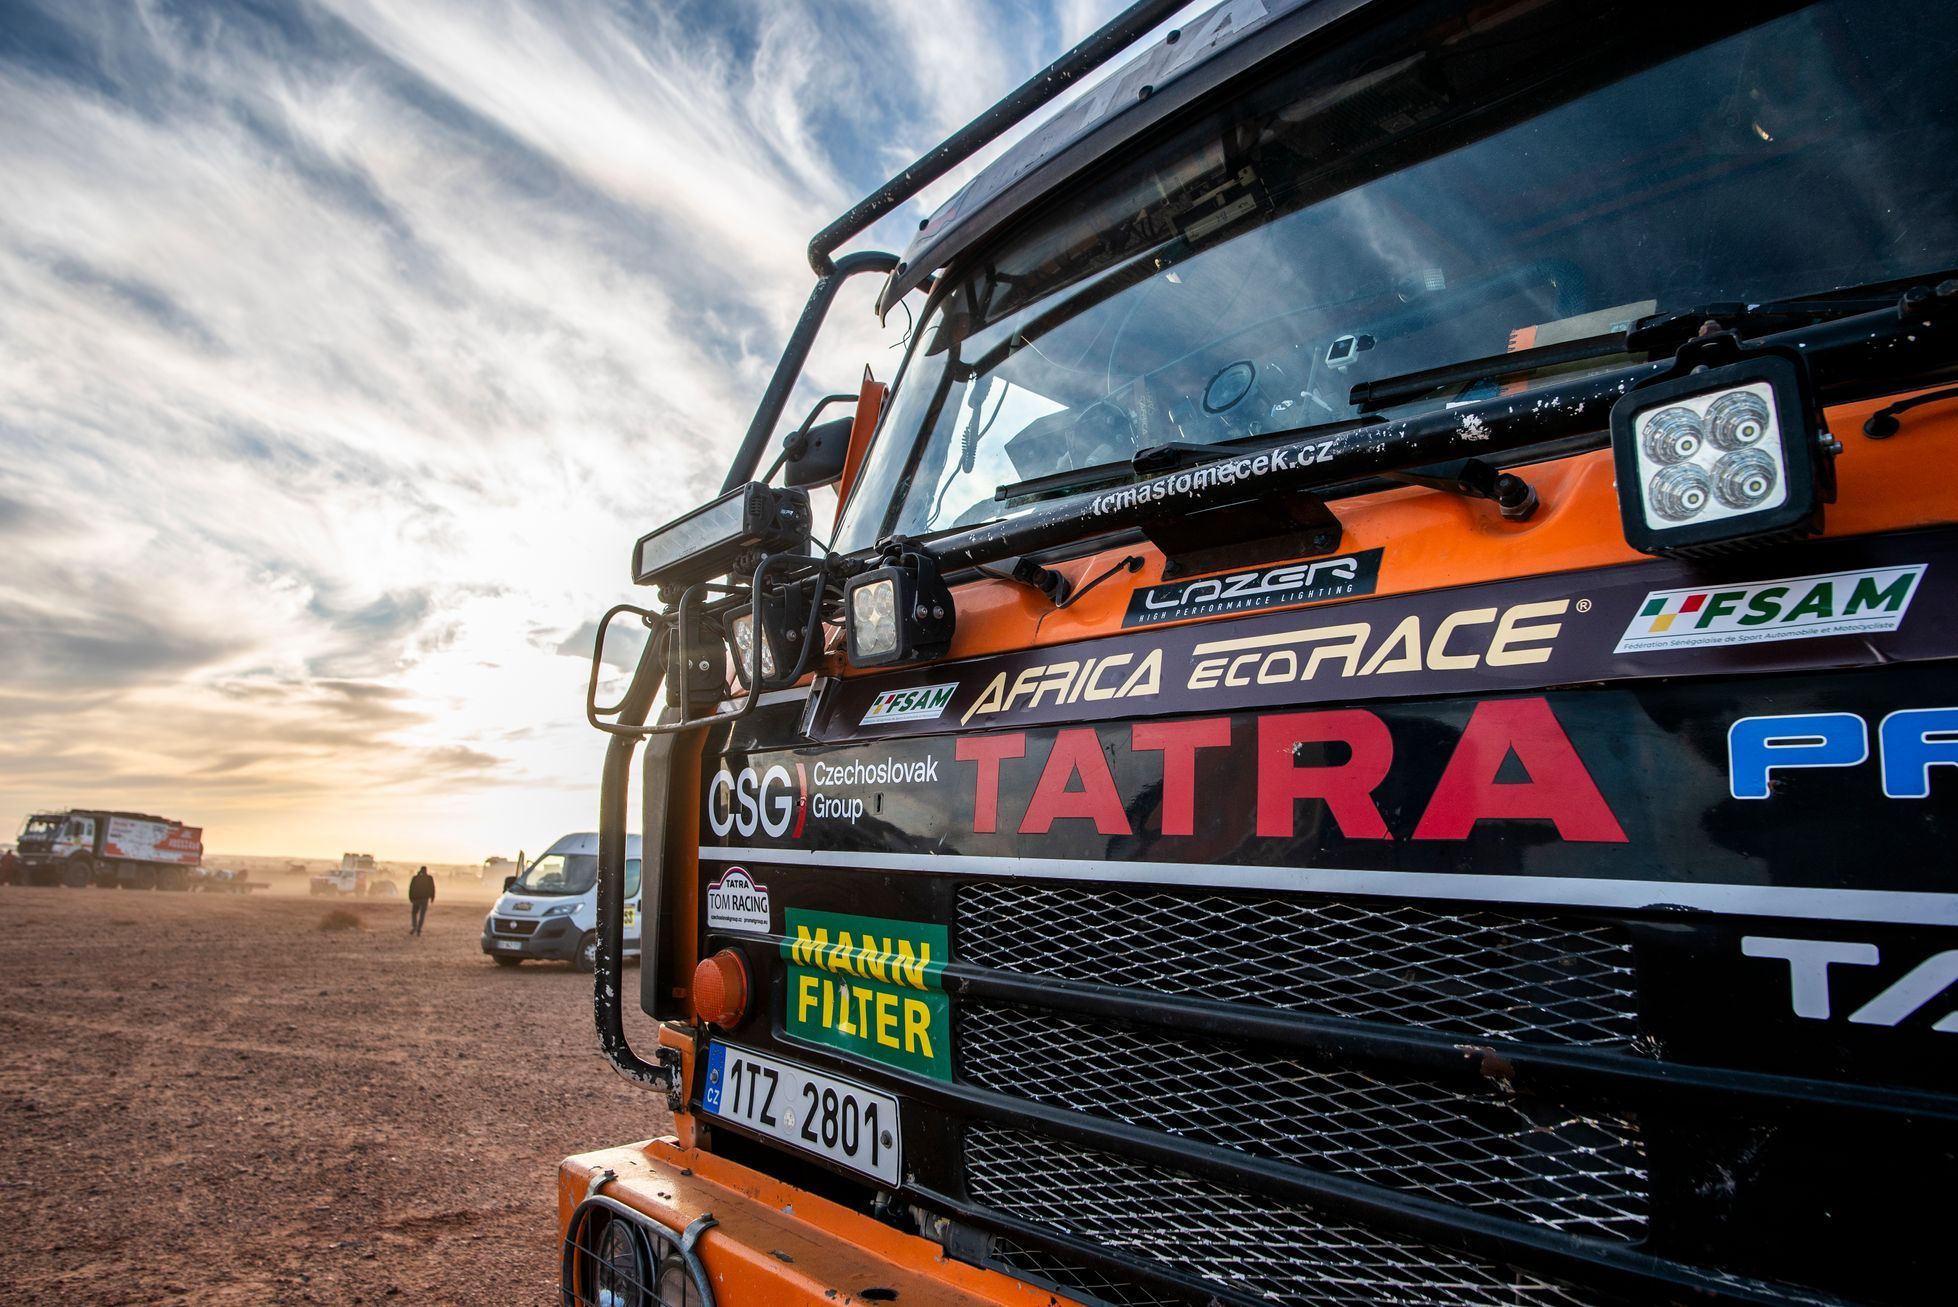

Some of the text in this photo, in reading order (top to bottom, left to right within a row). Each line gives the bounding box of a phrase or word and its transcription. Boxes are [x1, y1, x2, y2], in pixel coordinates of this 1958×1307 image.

[1145, 557, 1358, 610] LAZER
[1694, 572, 1917, 629] FSAM
[1138, 584, 1353, 623] HIGH PERFORMANCE LIGHTING
[1724, 634, 1736, 643] de
[1739, 631, 1763, 644] Sport
[1764, 626, 1819, 639] Automobile
[1821, 626, 1831, 634] et
[886, 687, 955, 713] FSAM
[961, 648, 1162, 726] AFRICA
[813, 755, 939, 786] Czechoslovak
[955, 697, 1631, 843] TATRA
[812, 793, 864, 824] Group
[709, 893, 768, 914] TOM RACING
[726, 879, 749, 889] TATRA
[792, 925, 930, 991] MANN
[798, 974, 934, 1059] FILTER
[706, 1086, 719, 1106] CZ
[731, 1059, 879, 1168] 1TZ 2801
